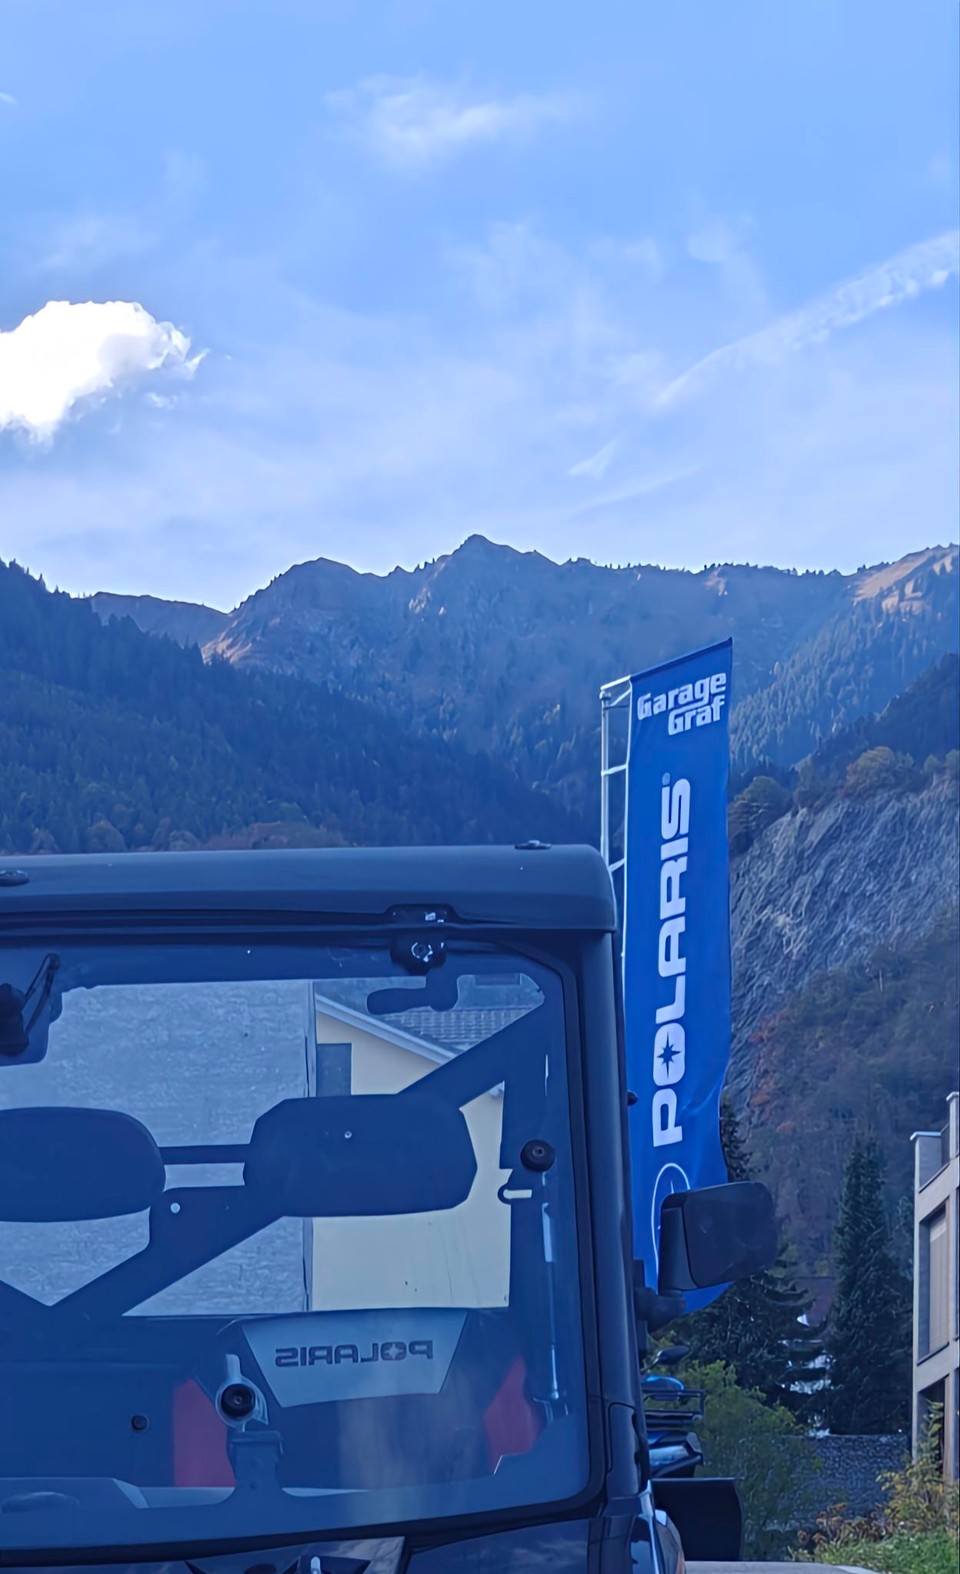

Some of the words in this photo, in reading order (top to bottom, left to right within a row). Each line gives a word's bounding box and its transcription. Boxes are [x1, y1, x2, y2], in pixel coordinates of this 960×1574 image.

[637, 672, 727, 721] Garage
[667, 694, 726, 736] Graf
[652, 777, 691, 1149] POLARIS
